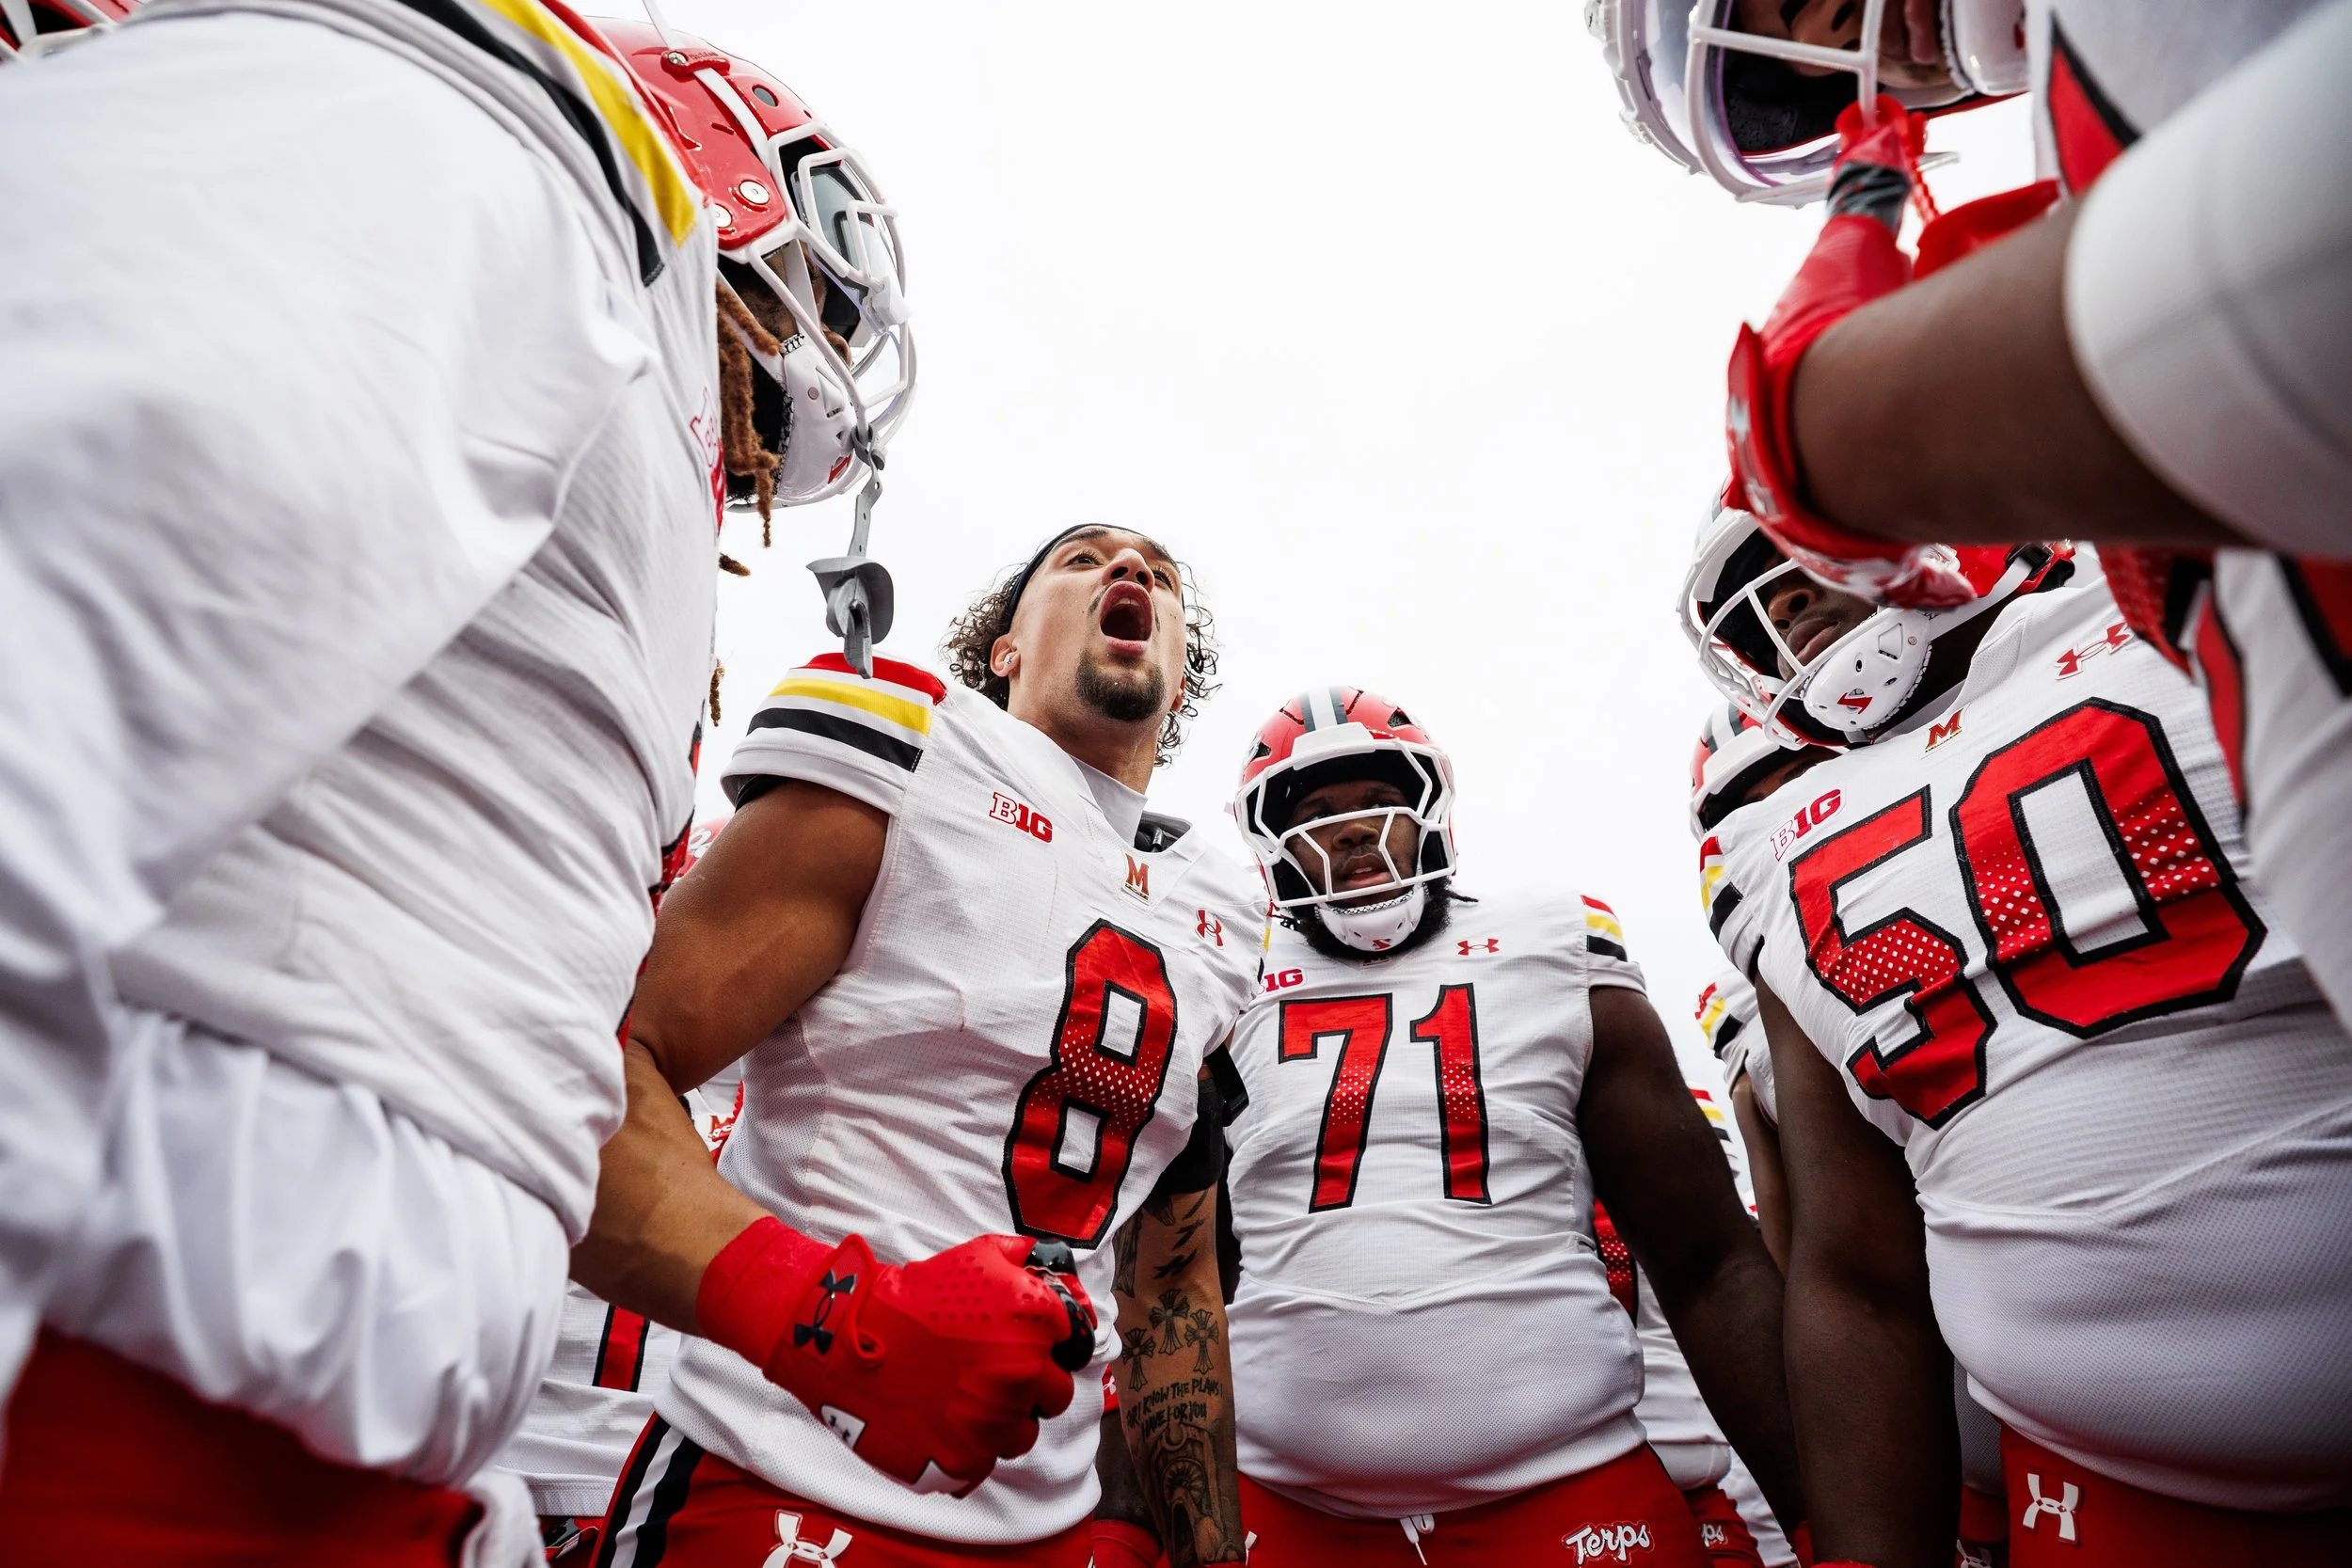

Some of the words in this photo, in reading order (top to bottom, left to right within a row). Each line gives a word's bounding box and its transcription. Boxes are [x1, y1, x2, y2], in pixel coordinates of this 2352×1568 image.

[1925, 707, 1963, 750] M
[1124, 852, 1150, 896] M
[1788, 697, 2268, 1131] 50
[1002, 918, 1178, 1249] 8
[1278, 982, 1492, 1213] 71
[1143, 1386, 1169, 1415] KNOW
[1170, 1382, 1189, 1400] THE
[1192, 1377, 1219, 1396] PLANS
[1188, 1401, 1207, 1422] YOU
[1565, 1524, 1650, 1565] Terps
